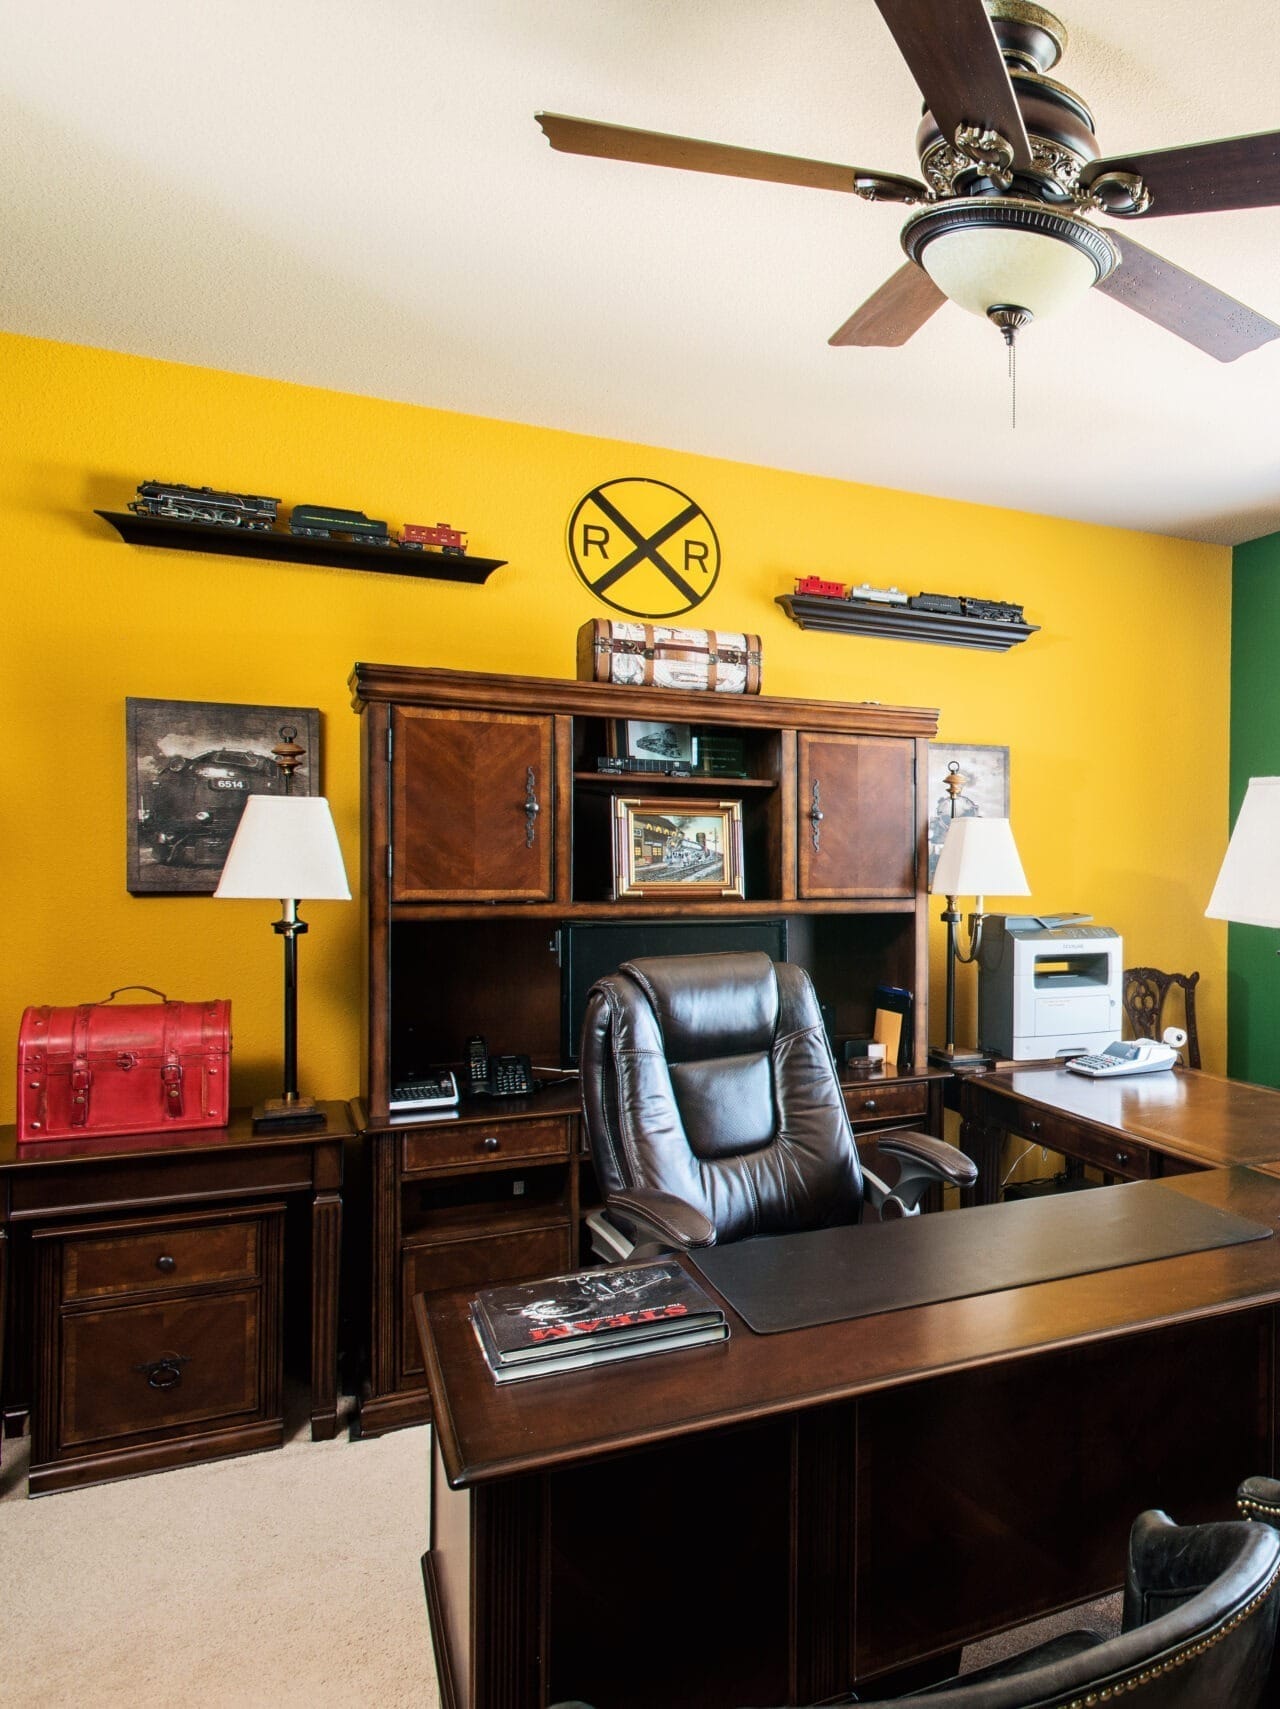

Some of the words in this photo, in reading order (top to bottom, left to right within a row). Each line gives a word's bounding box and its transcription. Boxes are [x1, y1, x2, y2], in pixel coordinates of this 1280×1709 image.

[582, 523, 610, 560] R
[683, 539, 709, 574] R
[217, 780, 244, 789] 6514
[528, 1304, 688, 1341] STEAM
